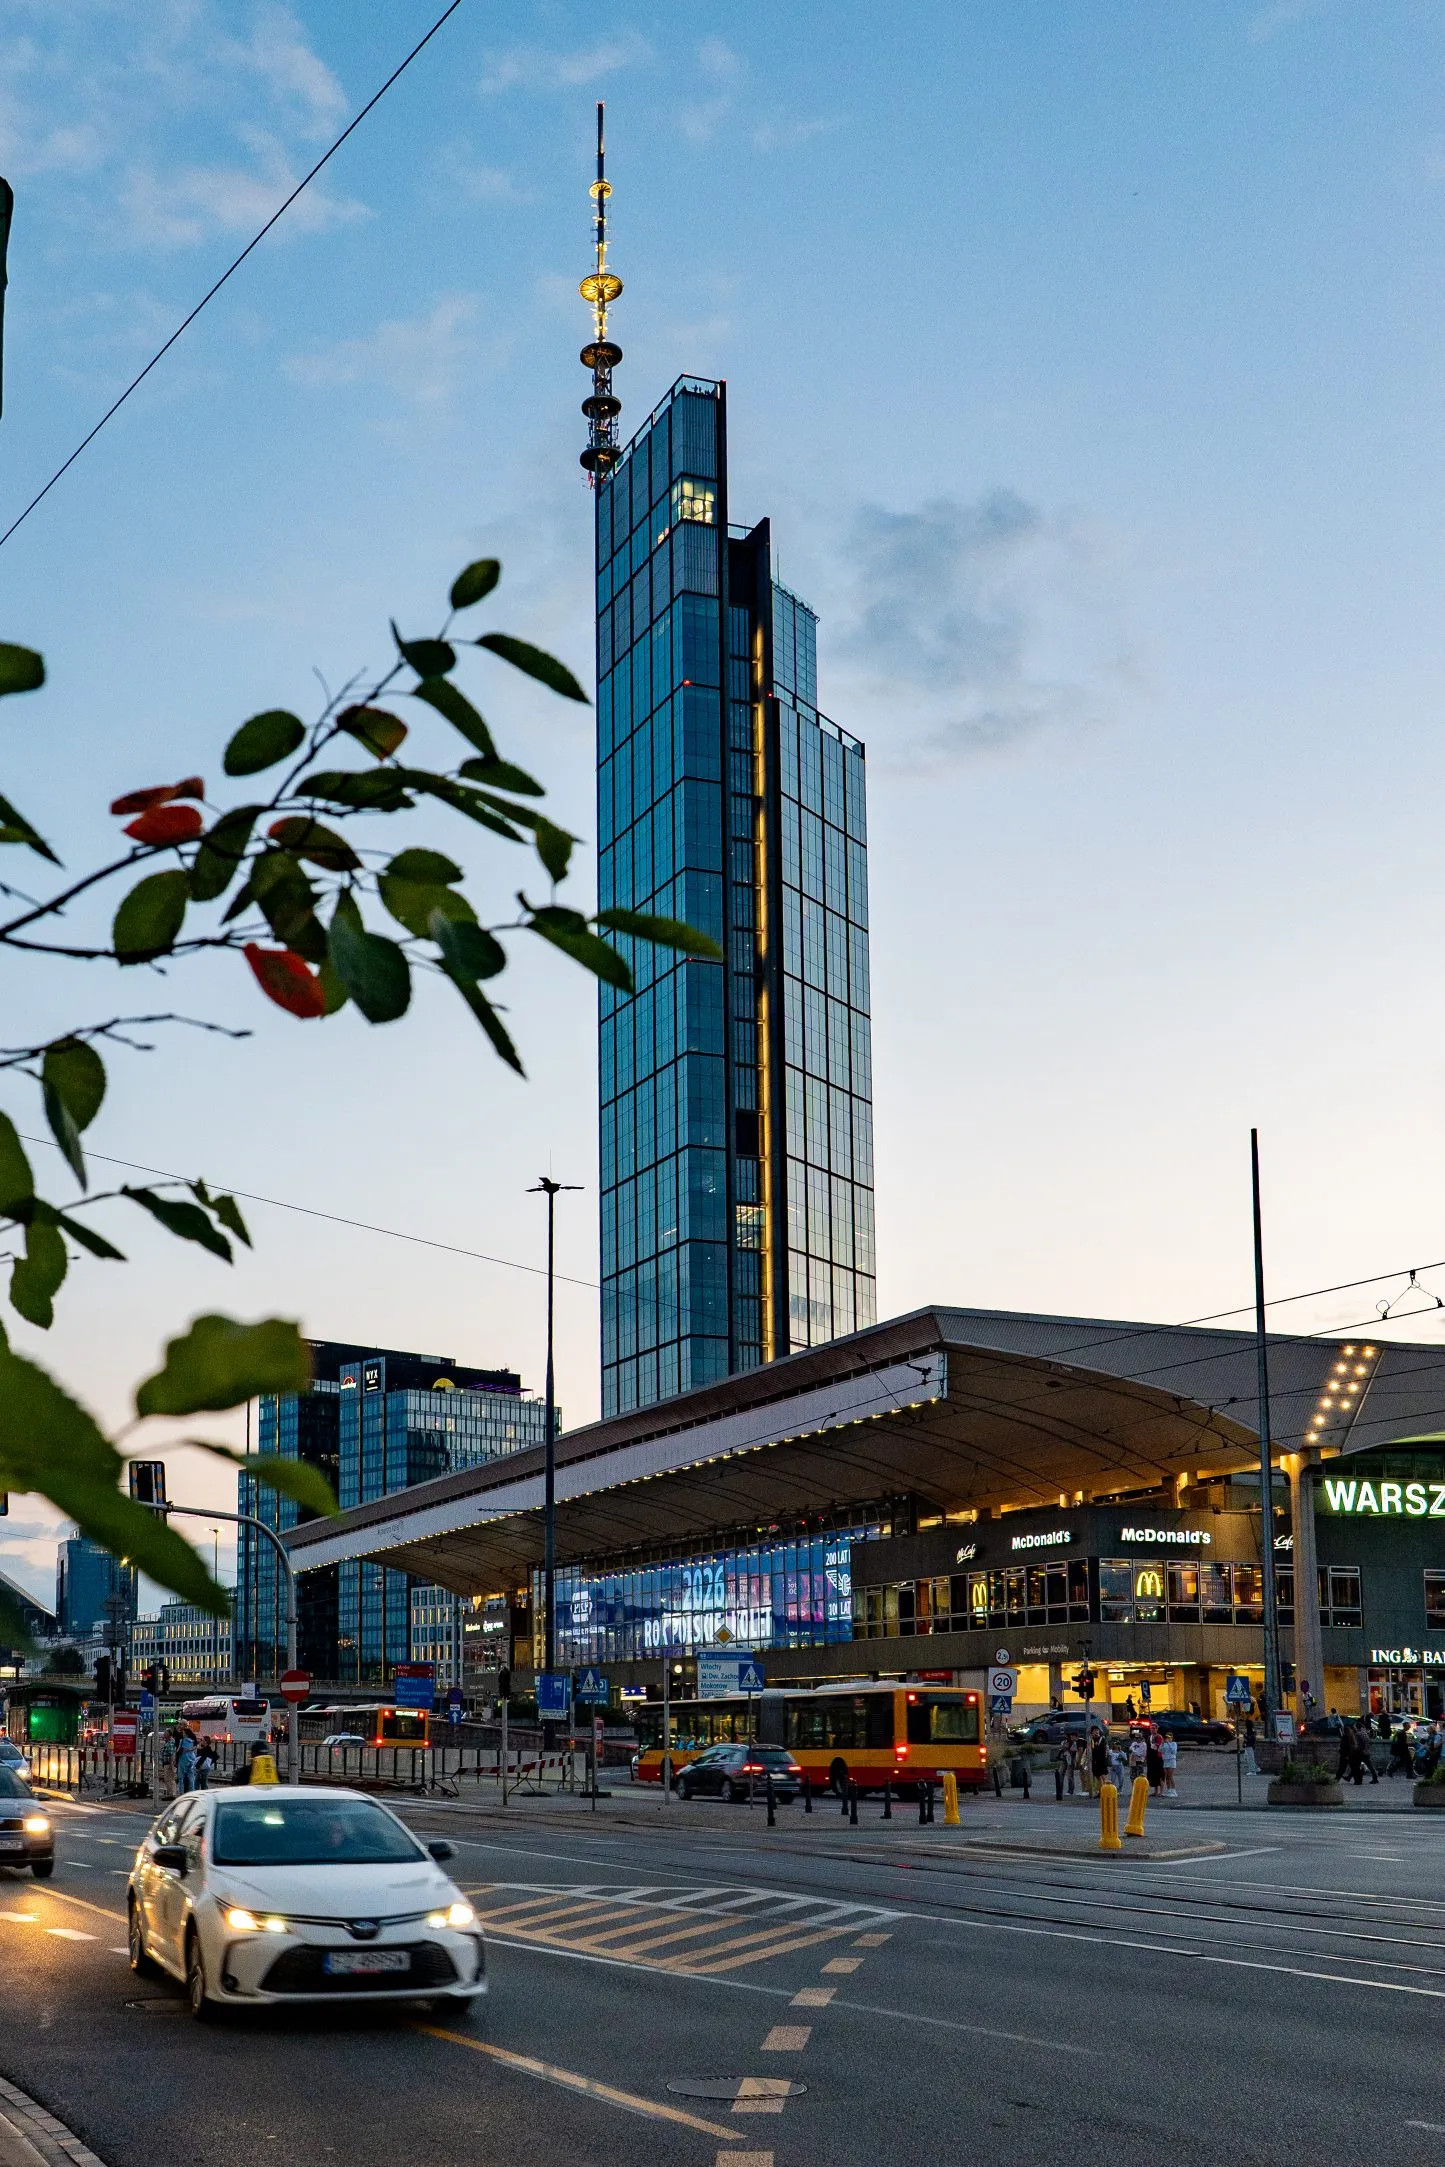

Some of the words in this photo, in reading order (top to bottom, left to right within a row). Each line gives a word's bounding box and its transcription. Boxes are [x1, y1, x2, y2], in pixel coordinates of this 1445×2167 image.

[1324, 1479, 1445, 1515] WARSZ
[1011, 1530, 1071, 1550] McDonald's
[1121, 1528, 1212, 1545] McDonald's
[837, 1549, 848, 1564] LAT
[682, 1565, 724, 1611] 2026
[644, 1612, 671, 1647] ROK
[1370, 1649, 1401, 1664] ING
[1422, 1650, 1445, 1664] BA
[996, 1677, 1010, 1687] 20
